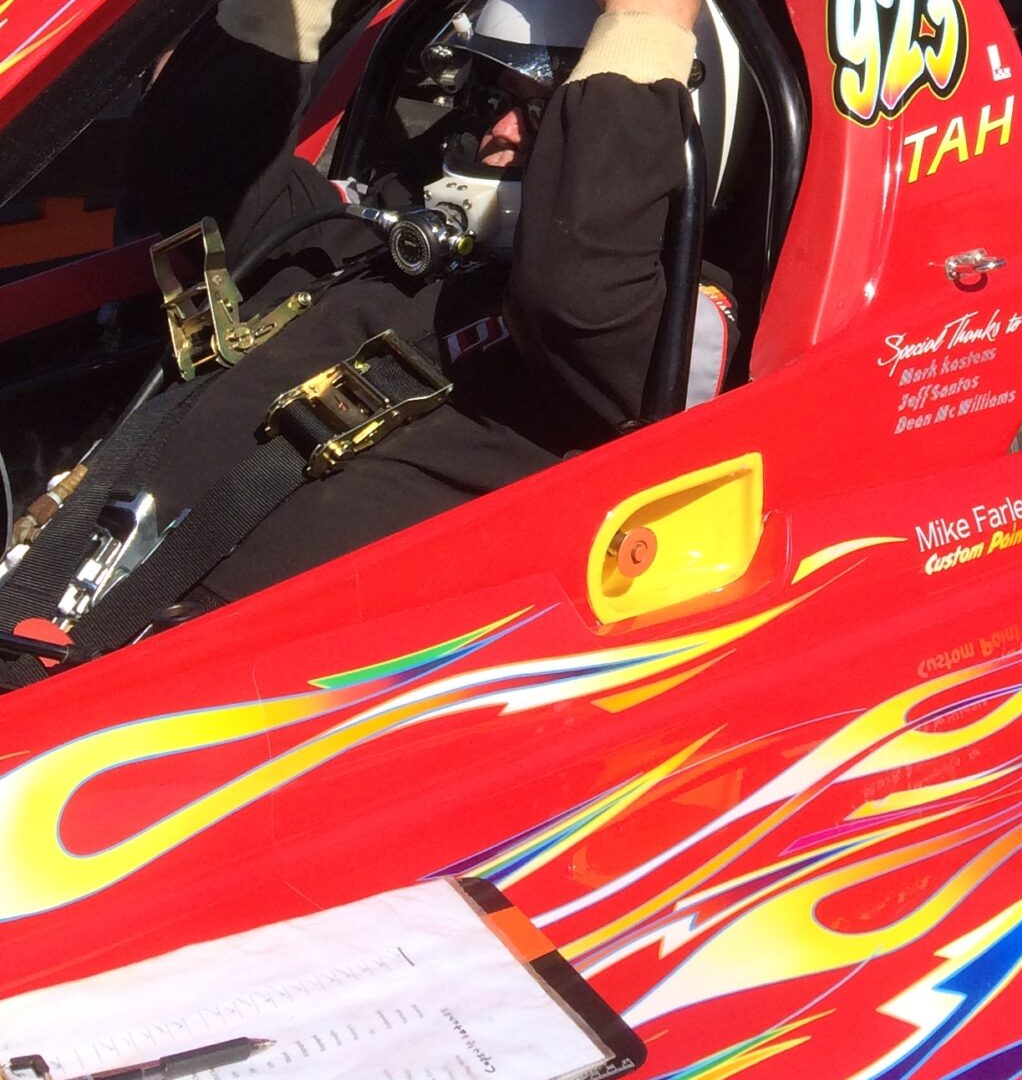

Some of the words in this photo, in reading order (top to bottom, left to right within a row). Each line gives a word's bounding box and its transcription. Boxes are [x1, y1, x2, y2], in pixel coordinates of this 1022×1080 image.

[903, 94, 1015, 184] TAH
[876, 328, 947, 377] Special
[944, 309, 1001, 350] Thanks
[897, 384, 932, 411] Jeff
[930, 376, 980, 401] Santos
[893, 412, 932, 434] Dean
[915, 518, 971, 553] Mike
[924, 542, 985, 576] Custom
